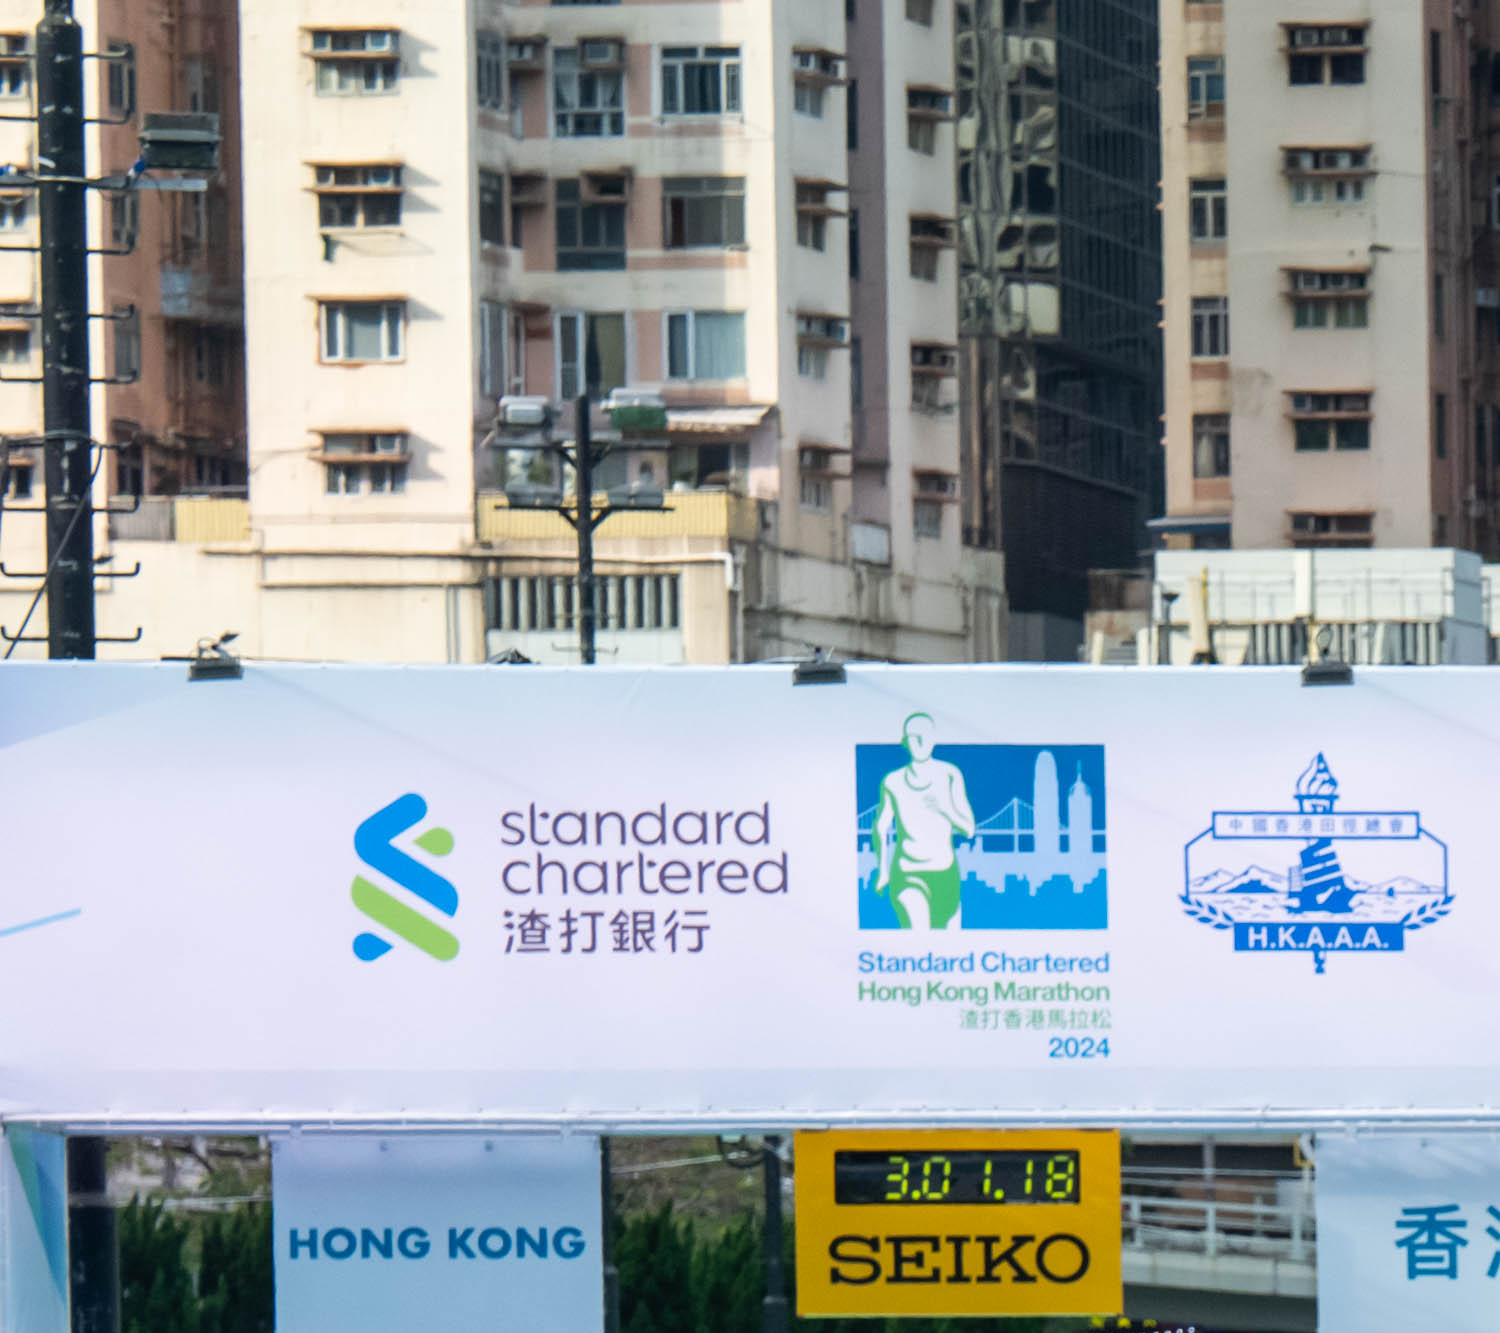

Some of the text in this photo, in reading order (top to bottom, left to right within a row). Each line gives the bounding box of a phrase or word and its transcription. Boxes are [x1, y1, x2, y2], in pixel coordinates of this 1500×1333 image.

[501, 802, 769, 847] standard
[502, 851, 788, 895] chartered
[504, 909, 710, 954] 渣打銀行
[1248, 927, 1390, 949] H.K.A.A.A.
[859, 953, 1110, 974] Standard Chartered
[859, 982, 1110, 1006] Hong Kong Marathon
[961, 1009, 1112, 1031] 渣打香港馬拉松
[1049, 1038, 1110, 1060] 2024
[290, 1226, 585, 1260] HONG KONG
[828, 1233, 1090, 1286] SEIKO
